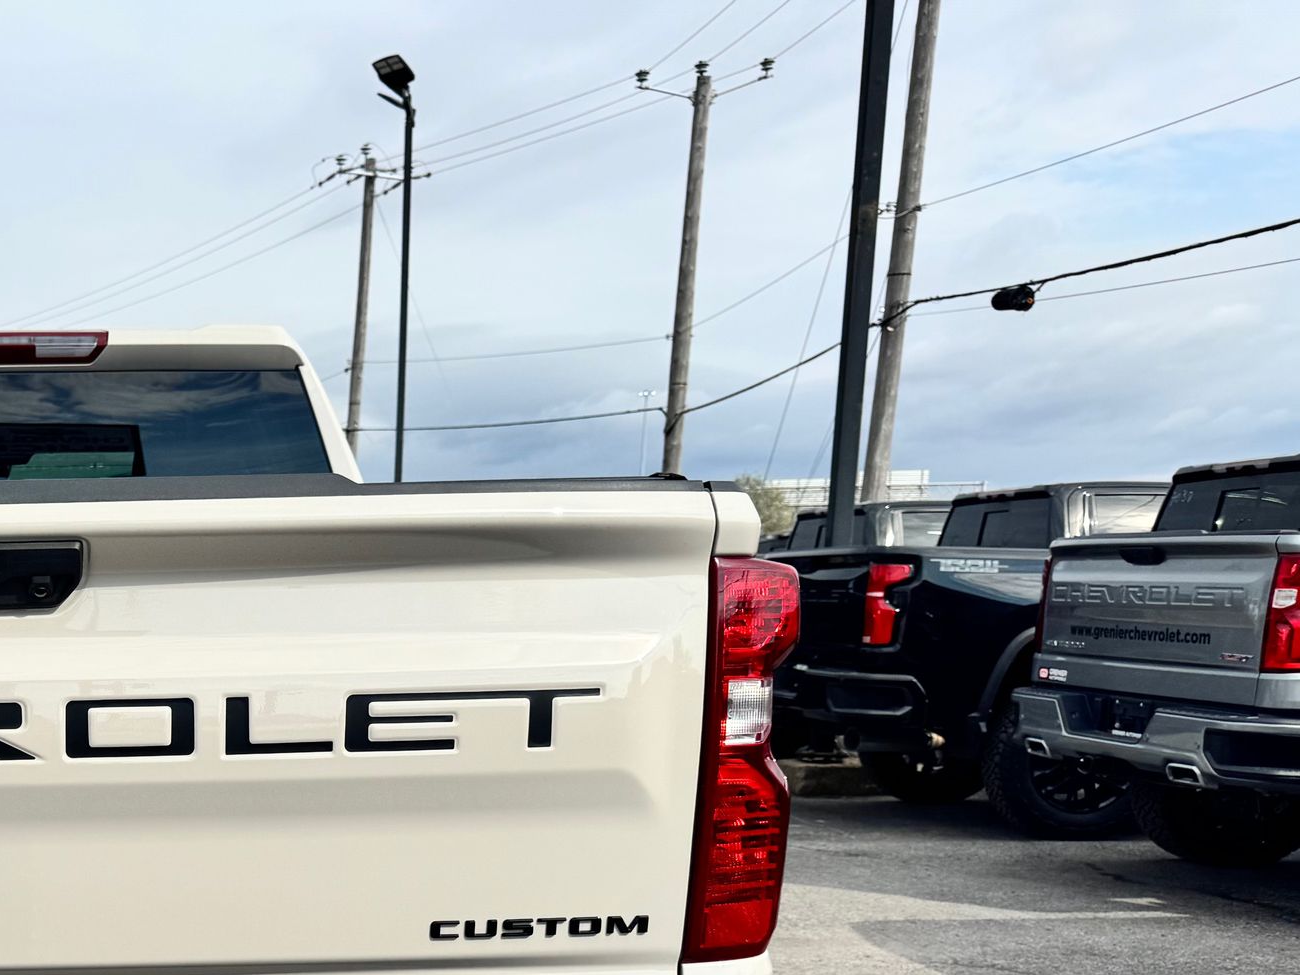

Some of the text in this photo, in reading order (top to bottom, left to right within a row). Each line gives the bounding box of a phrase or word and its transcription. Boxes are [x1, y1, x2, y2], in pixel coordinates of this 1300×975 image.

[1052, 584, 1244, 606] CHEVROLET
[1070, 624, 1211, 645] www.grenierchevrolet.com
[429, 914, 649, 941] CUSTOM
